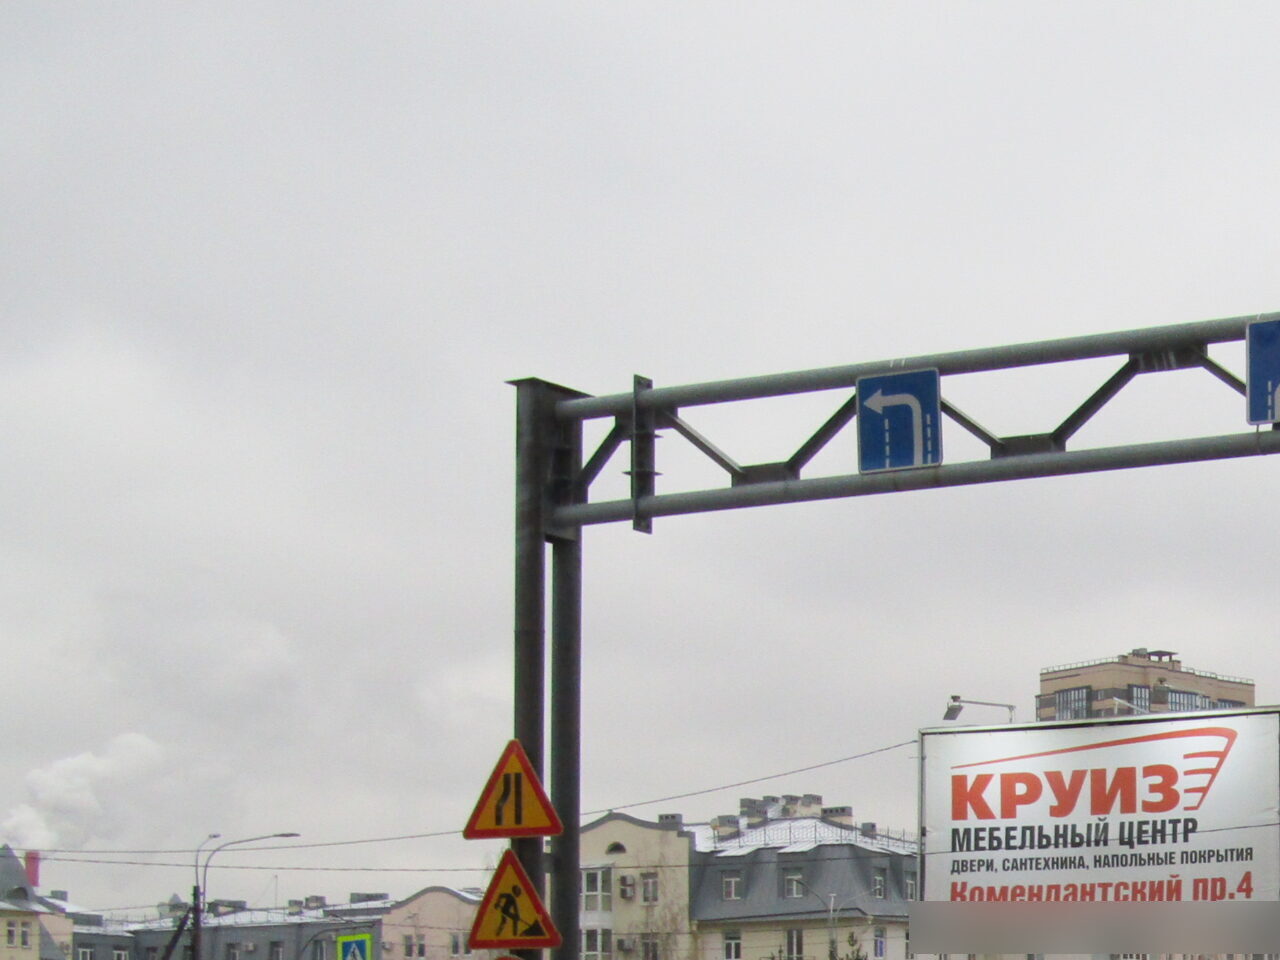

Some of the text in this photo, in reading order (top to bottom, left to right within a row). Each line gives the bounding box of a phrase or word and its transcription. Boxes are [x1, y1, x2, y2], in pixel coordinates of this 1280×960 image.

[951, 764, 1181, 821] КРУИЗ
[951, 816, 1198, 853] МЕБЕЛЬНЫЙ ЦЕНТР
[950, 847, 1254, 875] ДВЕРИ, САНТЕХНИКА, НАПОЛЬНЫЕ ПОКРЫТИЯ
[1193, 871, 1254, 902] пр.4
